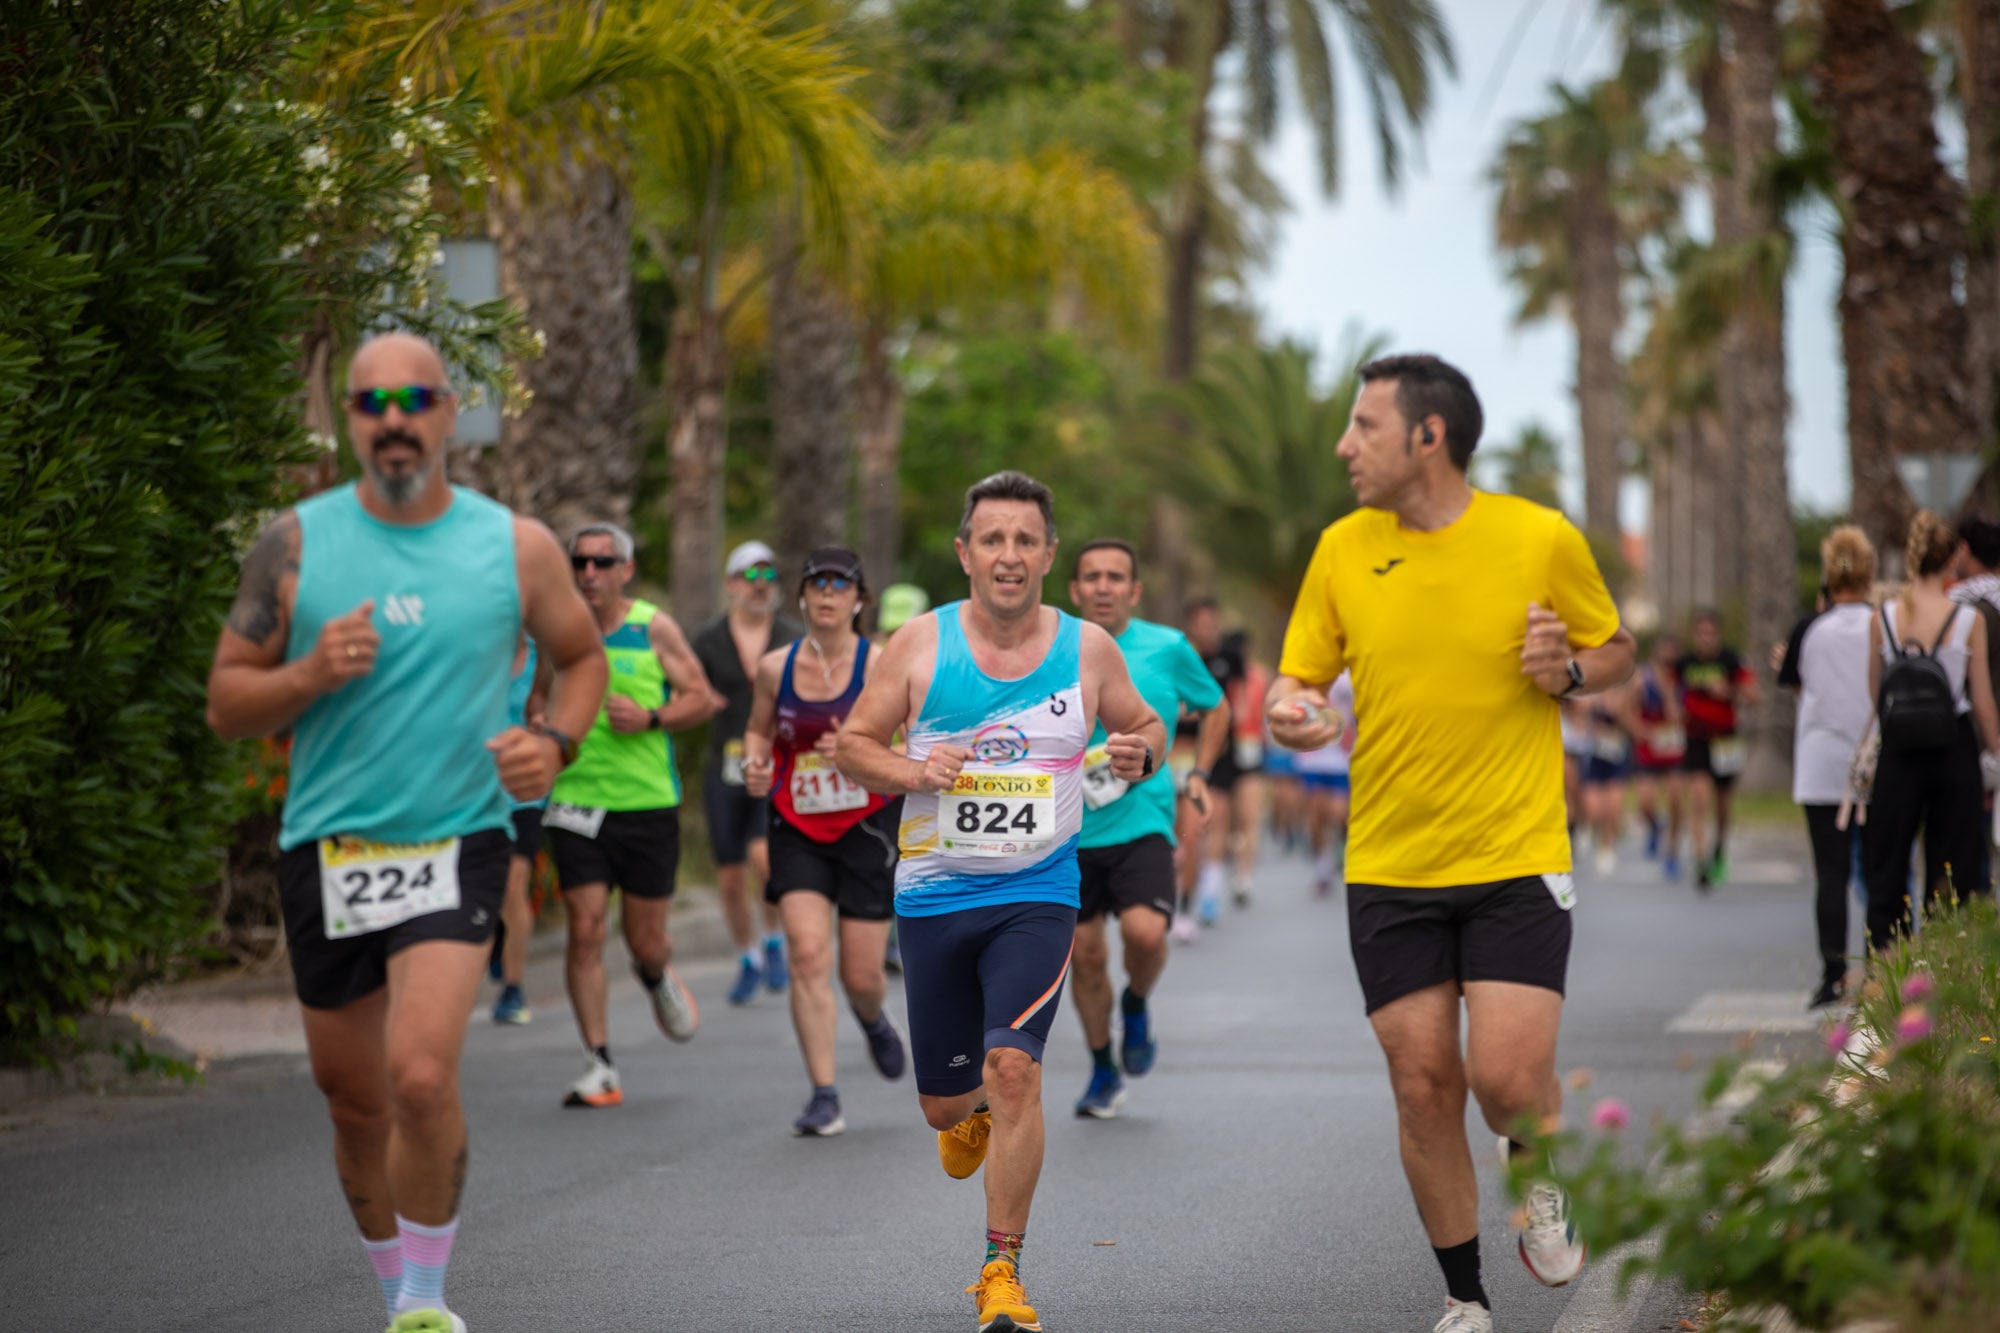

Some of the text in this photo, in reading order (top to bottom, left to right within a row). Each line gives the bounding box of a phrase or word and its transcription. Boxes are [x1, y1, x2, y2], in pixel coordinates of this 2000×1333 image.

[956, 775, 974, 790] 38
[956, 801, 1037, 834] 824
[344, 862, 434, 906] 224
